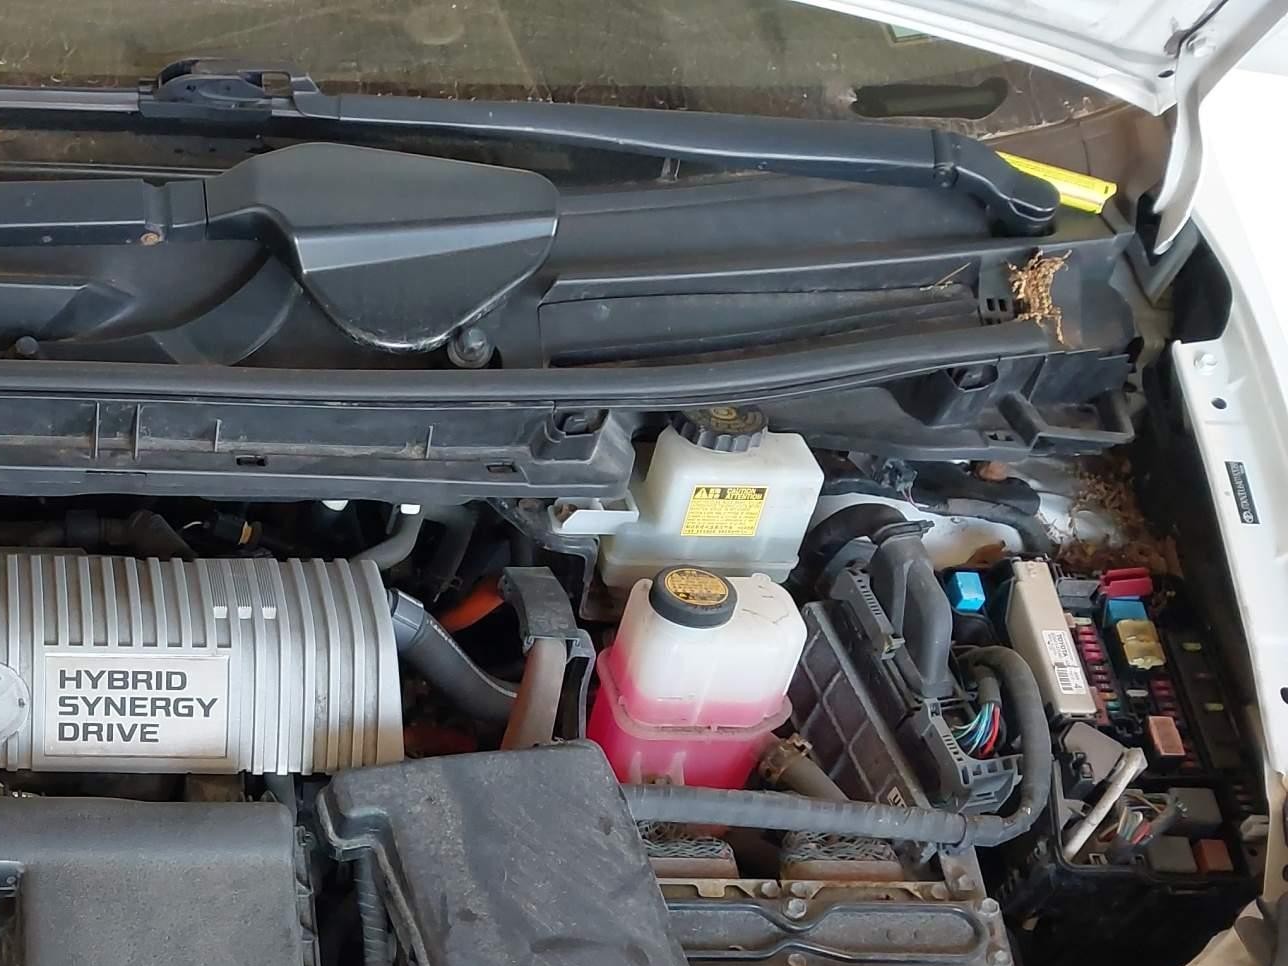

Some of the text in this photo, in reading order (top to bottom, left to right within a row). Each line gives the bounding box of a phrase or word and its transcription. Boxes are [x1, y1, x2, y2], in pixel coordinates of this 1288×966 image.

[59, 669, 187, 691] HYBRID
[58, 696, 218, 717] SYNERGY
[58, 722, 159, 742] DRIVE
